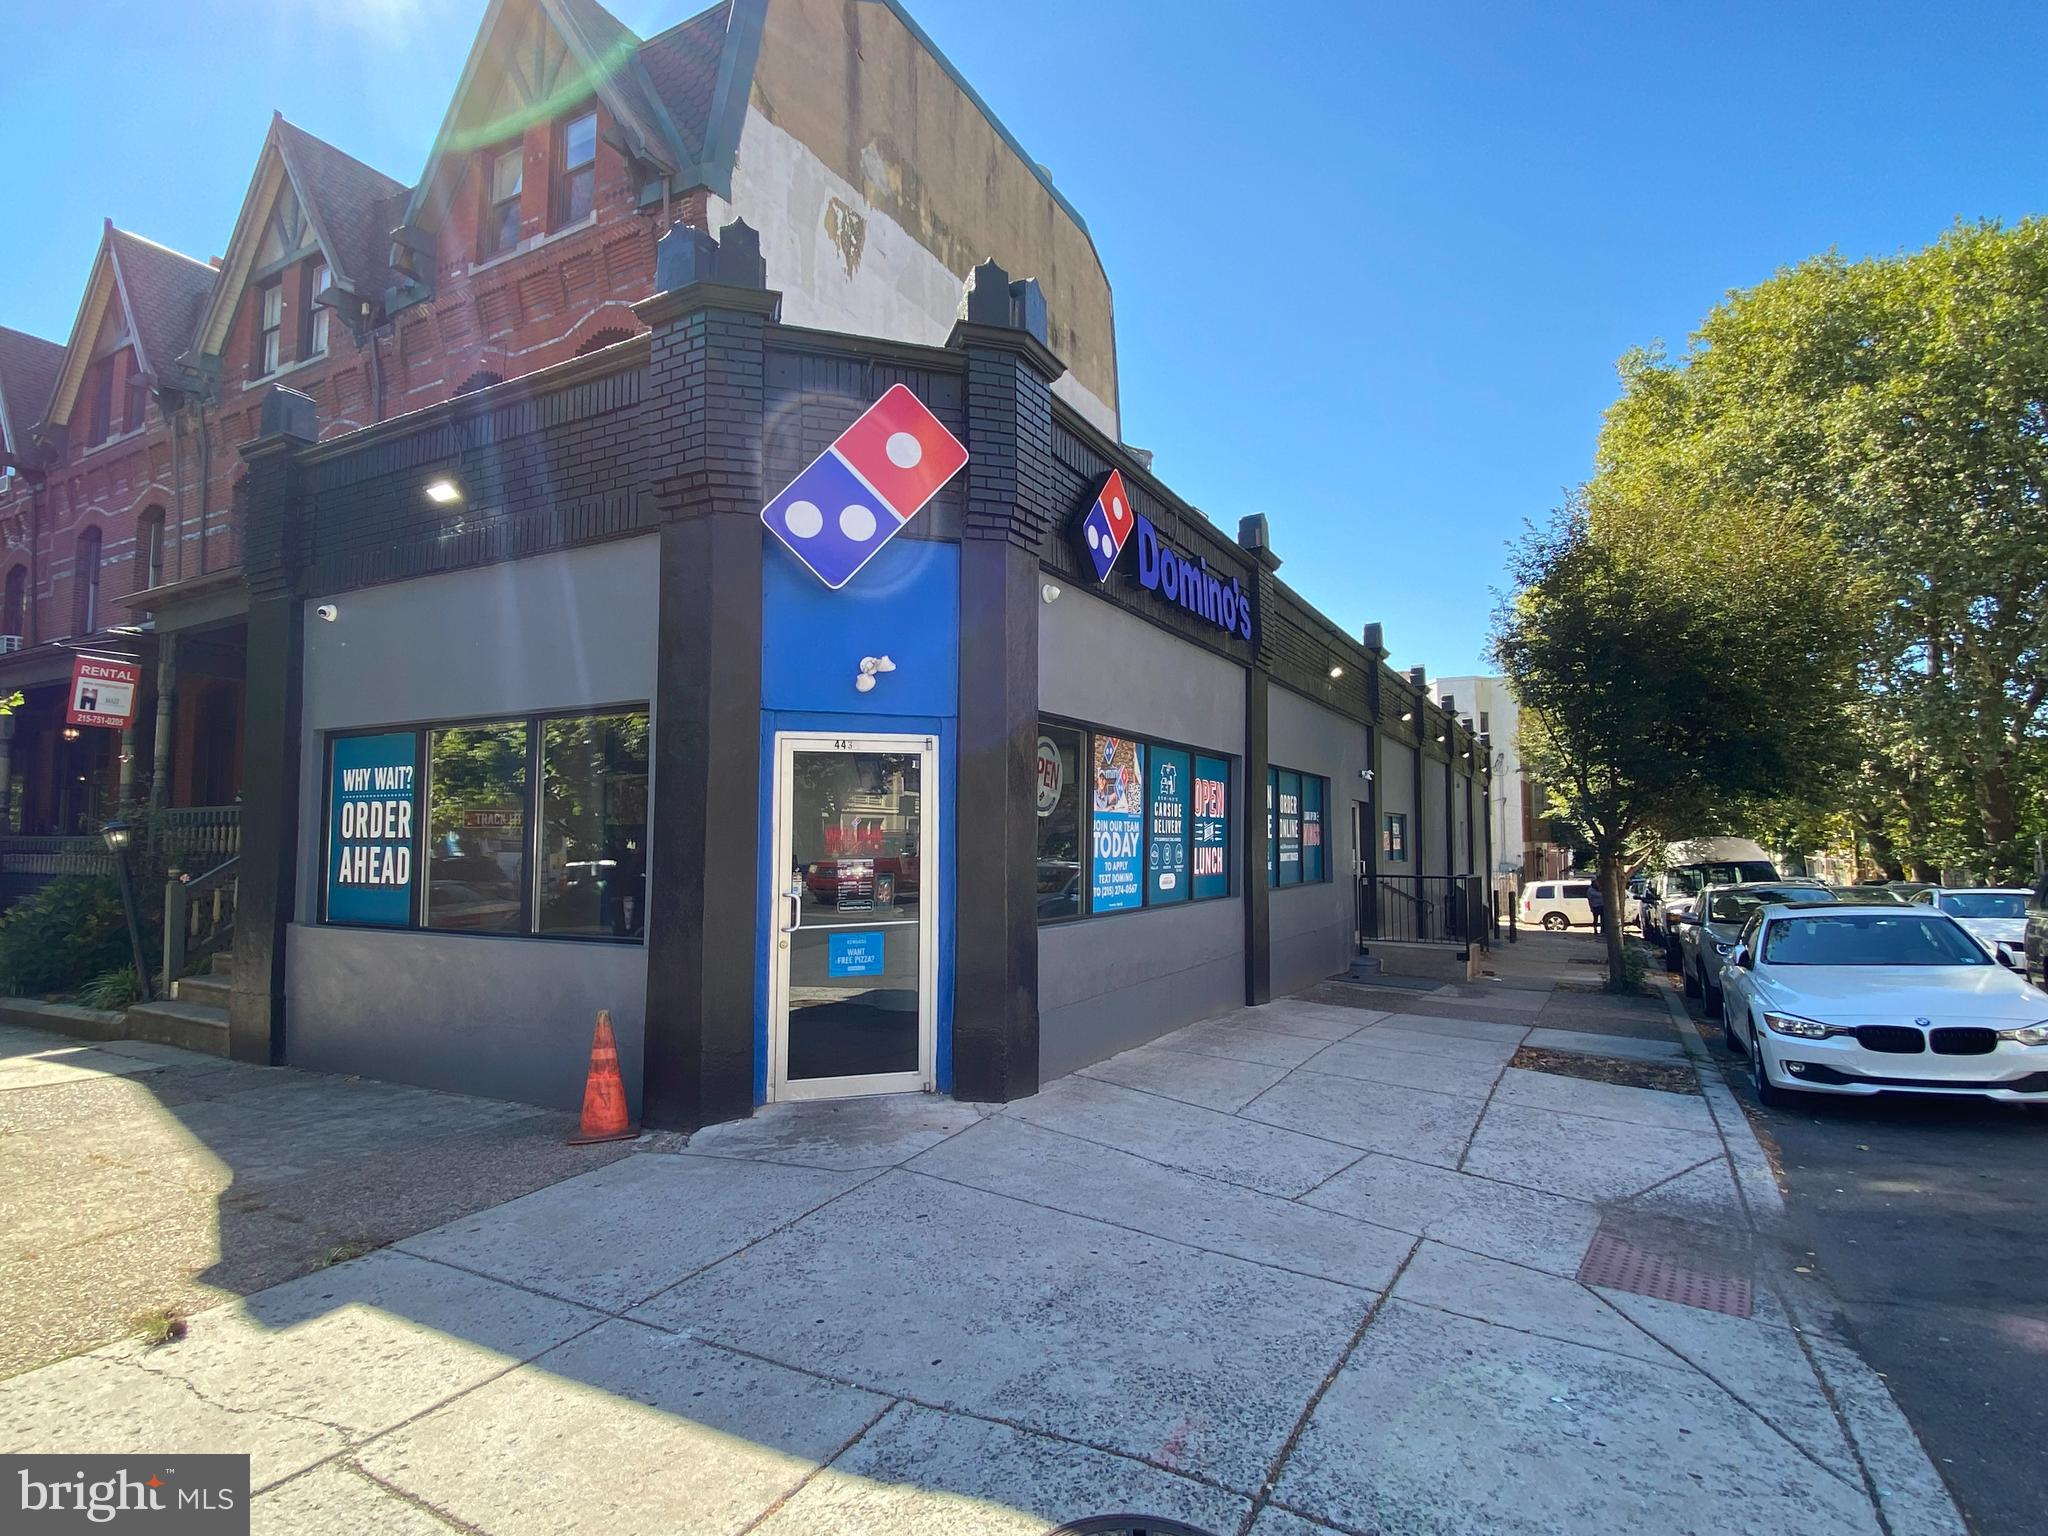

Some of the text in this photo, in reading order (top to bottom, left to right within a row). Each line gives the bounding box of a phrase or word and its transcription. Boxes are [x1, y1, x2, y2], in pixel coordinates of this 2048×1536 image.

[1137, 511, 1251, 640] Domino's
[81, 665, 134, 681] RENTAL
[834, 740, 853, 750] 443
[343, 766, 413, 791] WHY WAIT?
[1038, 757, 1060, 790] PEN
[1194, 778, 1225, 818] OPEN
[1280, 794, 1298, 815] ORDER
[1154, 802, 1182, 818] CARSIDE
[341, 800, 411, 839] ORDER
[1093, 820, 1139, 833] JOIN OUR TEAM
[1153, 819, 1182, 834] DELIVERY
[1280, 818, 1298, 838] ONLINE
[1093, 831, 1139, 858] TODAY
[339, 846, 410, 885] AHEAD
[1104, 861, 1128, 871] TO APPLY
[1194, 847, 1223, 874] LUNCH
[1098, 872, 1133, 884] TEXT DOMINO
[1093, 887, 1101, 897] TO
[837, 954, 875, 965] FREE PIZZA?
[847, 948, 865, 956] WANT
